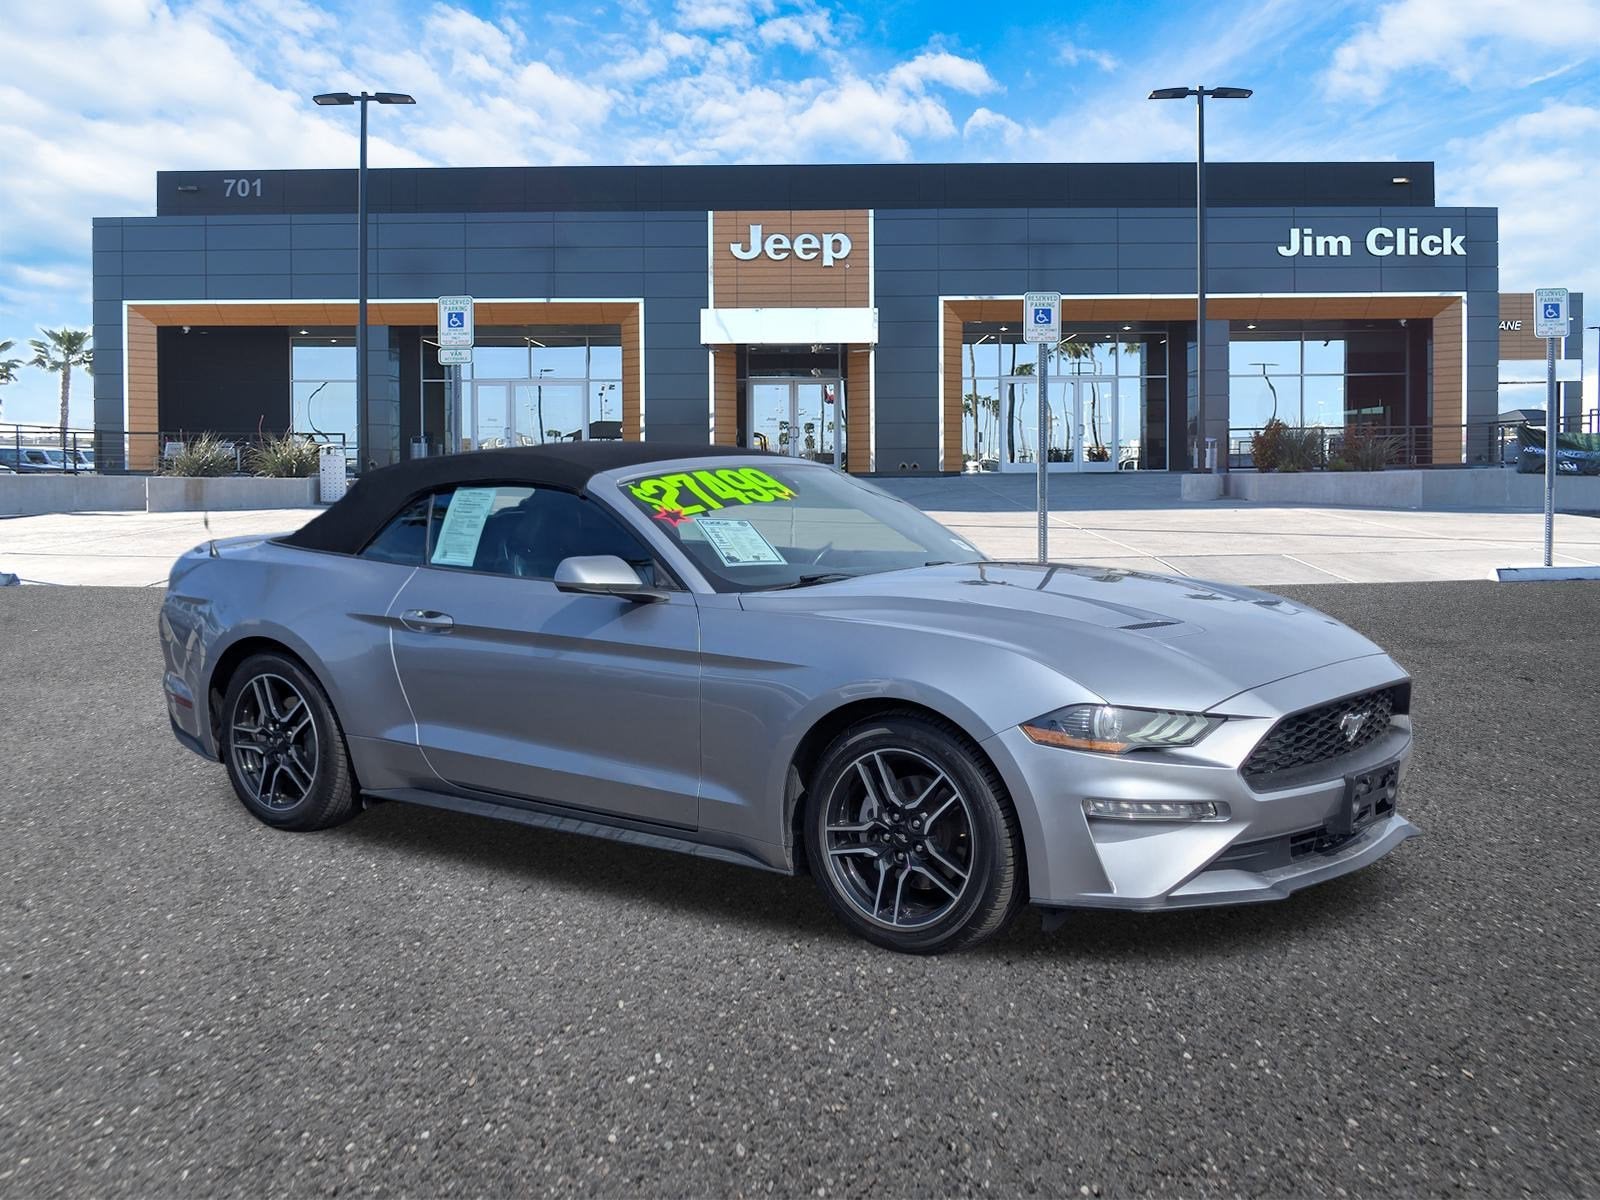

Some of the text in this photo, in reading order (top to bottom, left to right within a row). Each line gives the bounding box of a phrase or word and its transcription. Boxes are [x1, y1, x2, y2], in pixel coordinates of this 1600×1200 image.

[223, 178, 262, 198] 701
[729, 223, 852, 268] Jeep
[1277, 227, 1467, 257] Jim Click
